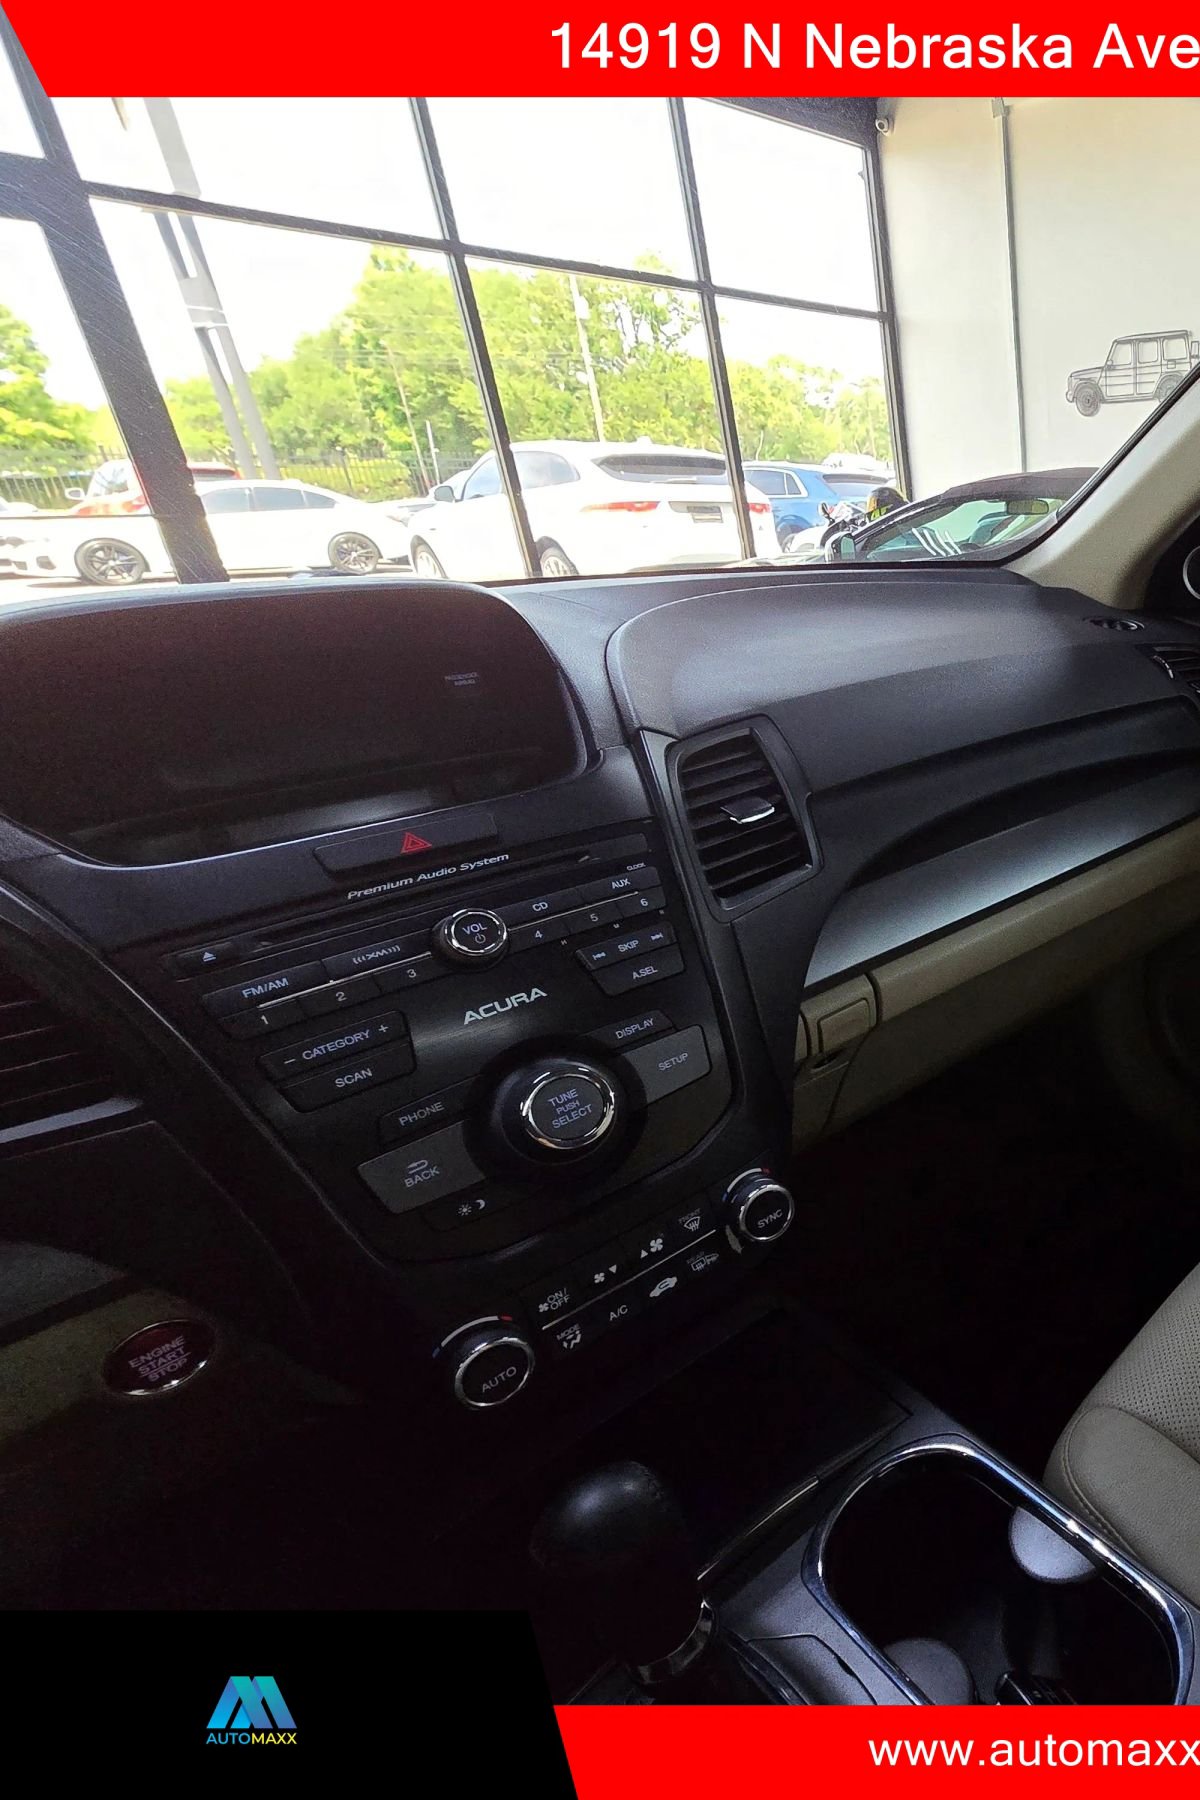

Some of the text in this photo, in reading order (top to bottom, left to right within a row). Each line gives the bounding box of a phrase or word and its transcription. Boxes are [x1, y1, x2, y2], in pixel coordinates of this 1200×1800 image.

[347, 853, 510, 899] Premium Audio System
[611, 878, 631, 889] AUX
[532, 901, 549, 912] CD
[640, 898, 649, 907] 6
[589, 913, 599, 922] 5
[462, 922, 488, 935] VOL
[534, 929, 543, 939] 4
[617, 939, 640, 952] SKIP
[405, 968, 417, 979] 3
[241, 977, 290, 999] FM/AM
[335, 991, 347, 1002] 2
[463, 987, 548, 1025] ACURA
[260, 1014, 269, 1026] 1
[615, 1018, 654, 1039] DISPLAY
[301, 1029, 371, 1060] CATEGORY
[658, 1052, 688, 1071] SETUP
[334, 1068, 373, 1088] SCAN
[547, 1088, 579, 1107] TUNE
[555, 1099, 580, 1115] PUSH
[398, 1101, 445, 1126] PHONE
[551, 1103, 592, 1129] SELECT
[404, 1165, 440, 1188] BACK
[757, 1208, 783, 1229] SYNC
[550, 1293, 570, 1310] OFF
[609, 1304, 629, 1322] A/C
[556, 1323, 581, 1341] MODE
[128, 1335, 185, 1368] ENGINE
[138, 1345, 185, 1375] START
[147, 1357, 188, 1382] STOP
[482, 1366, 517, 1393] AUTO
